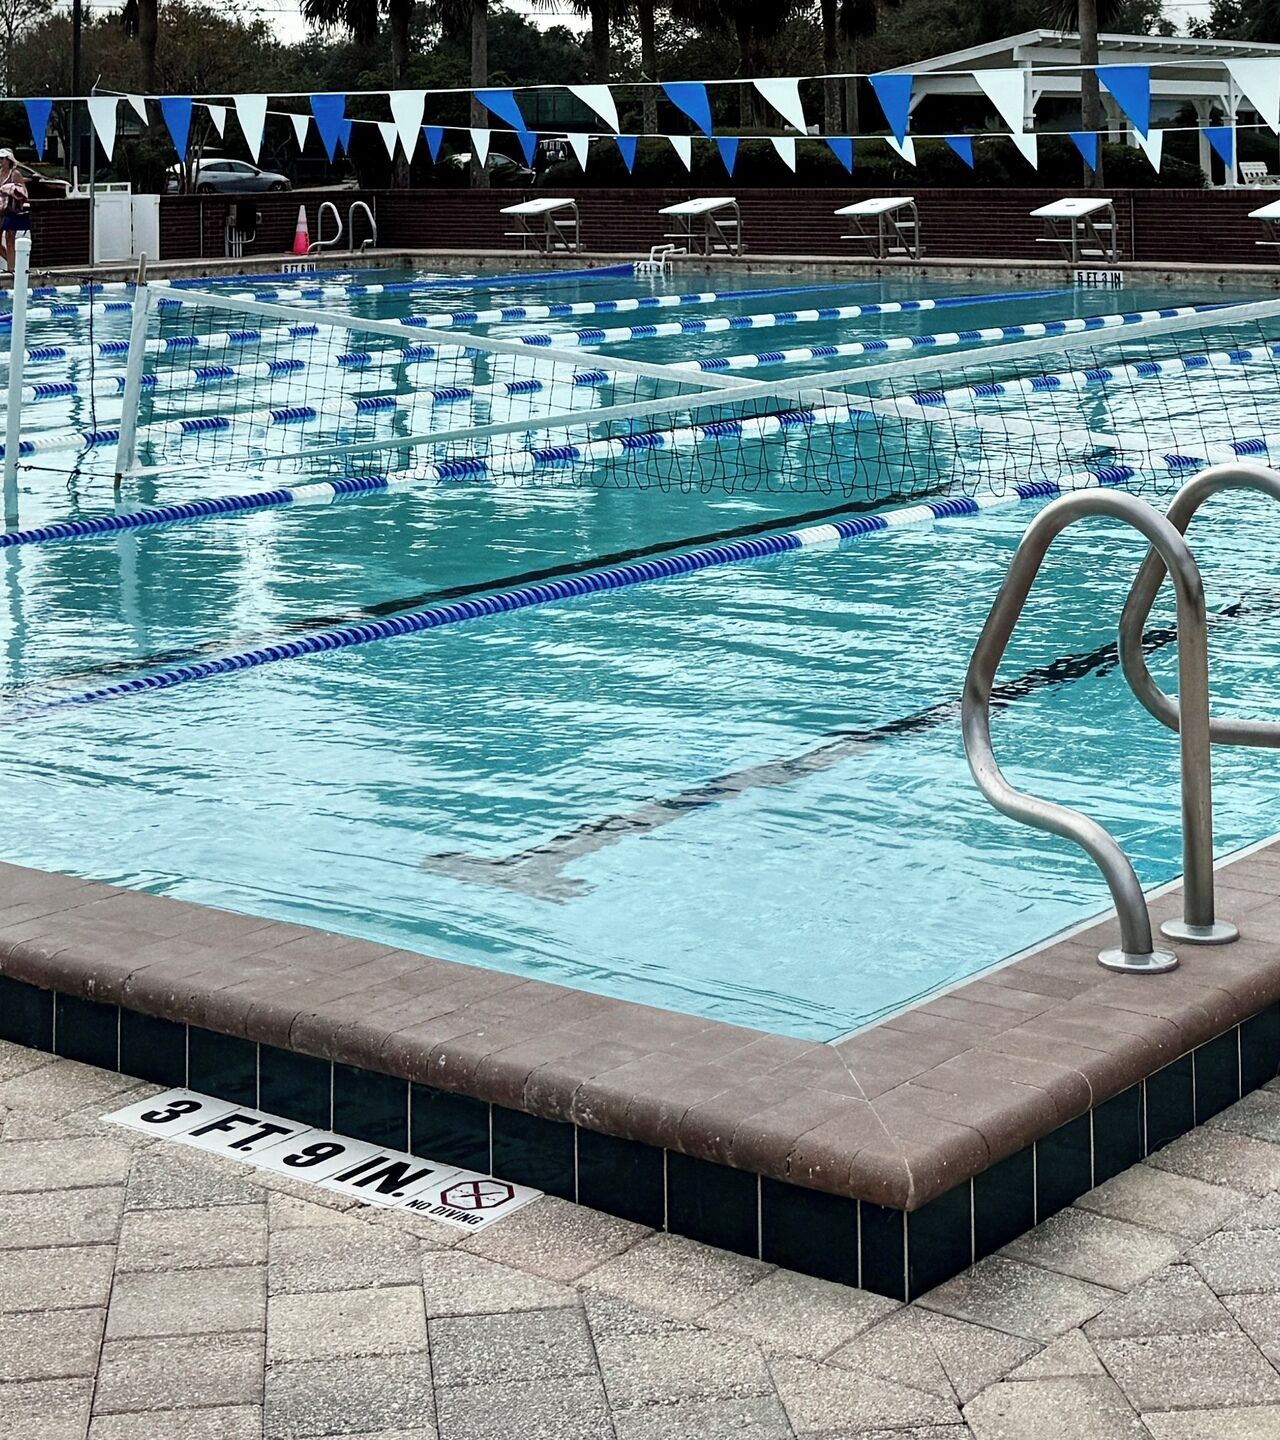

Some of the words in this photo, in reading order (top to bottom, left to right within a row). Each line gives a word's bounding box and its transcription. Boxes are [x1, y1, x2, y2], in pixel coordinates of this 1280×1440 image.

[291, 265, 298, 273] FT
[307, 264, 314, 272] IN
[1077, 272, 1083, 282] 5
[1087, 272, 1098, 282] FT
[1101, 272, 1107, 282] 3
[1111, 273, 1120, 283] IN
[140, 1100, 203, 1123] 3
[188, 1113, 294, 1151] FT.
[282, 1142, 346, 1168] 9
[333, 1156, 435, 1197] IN.
[405, 1199, 429, 1211] NO
[429, 1205, 484, 1225] DIVING
